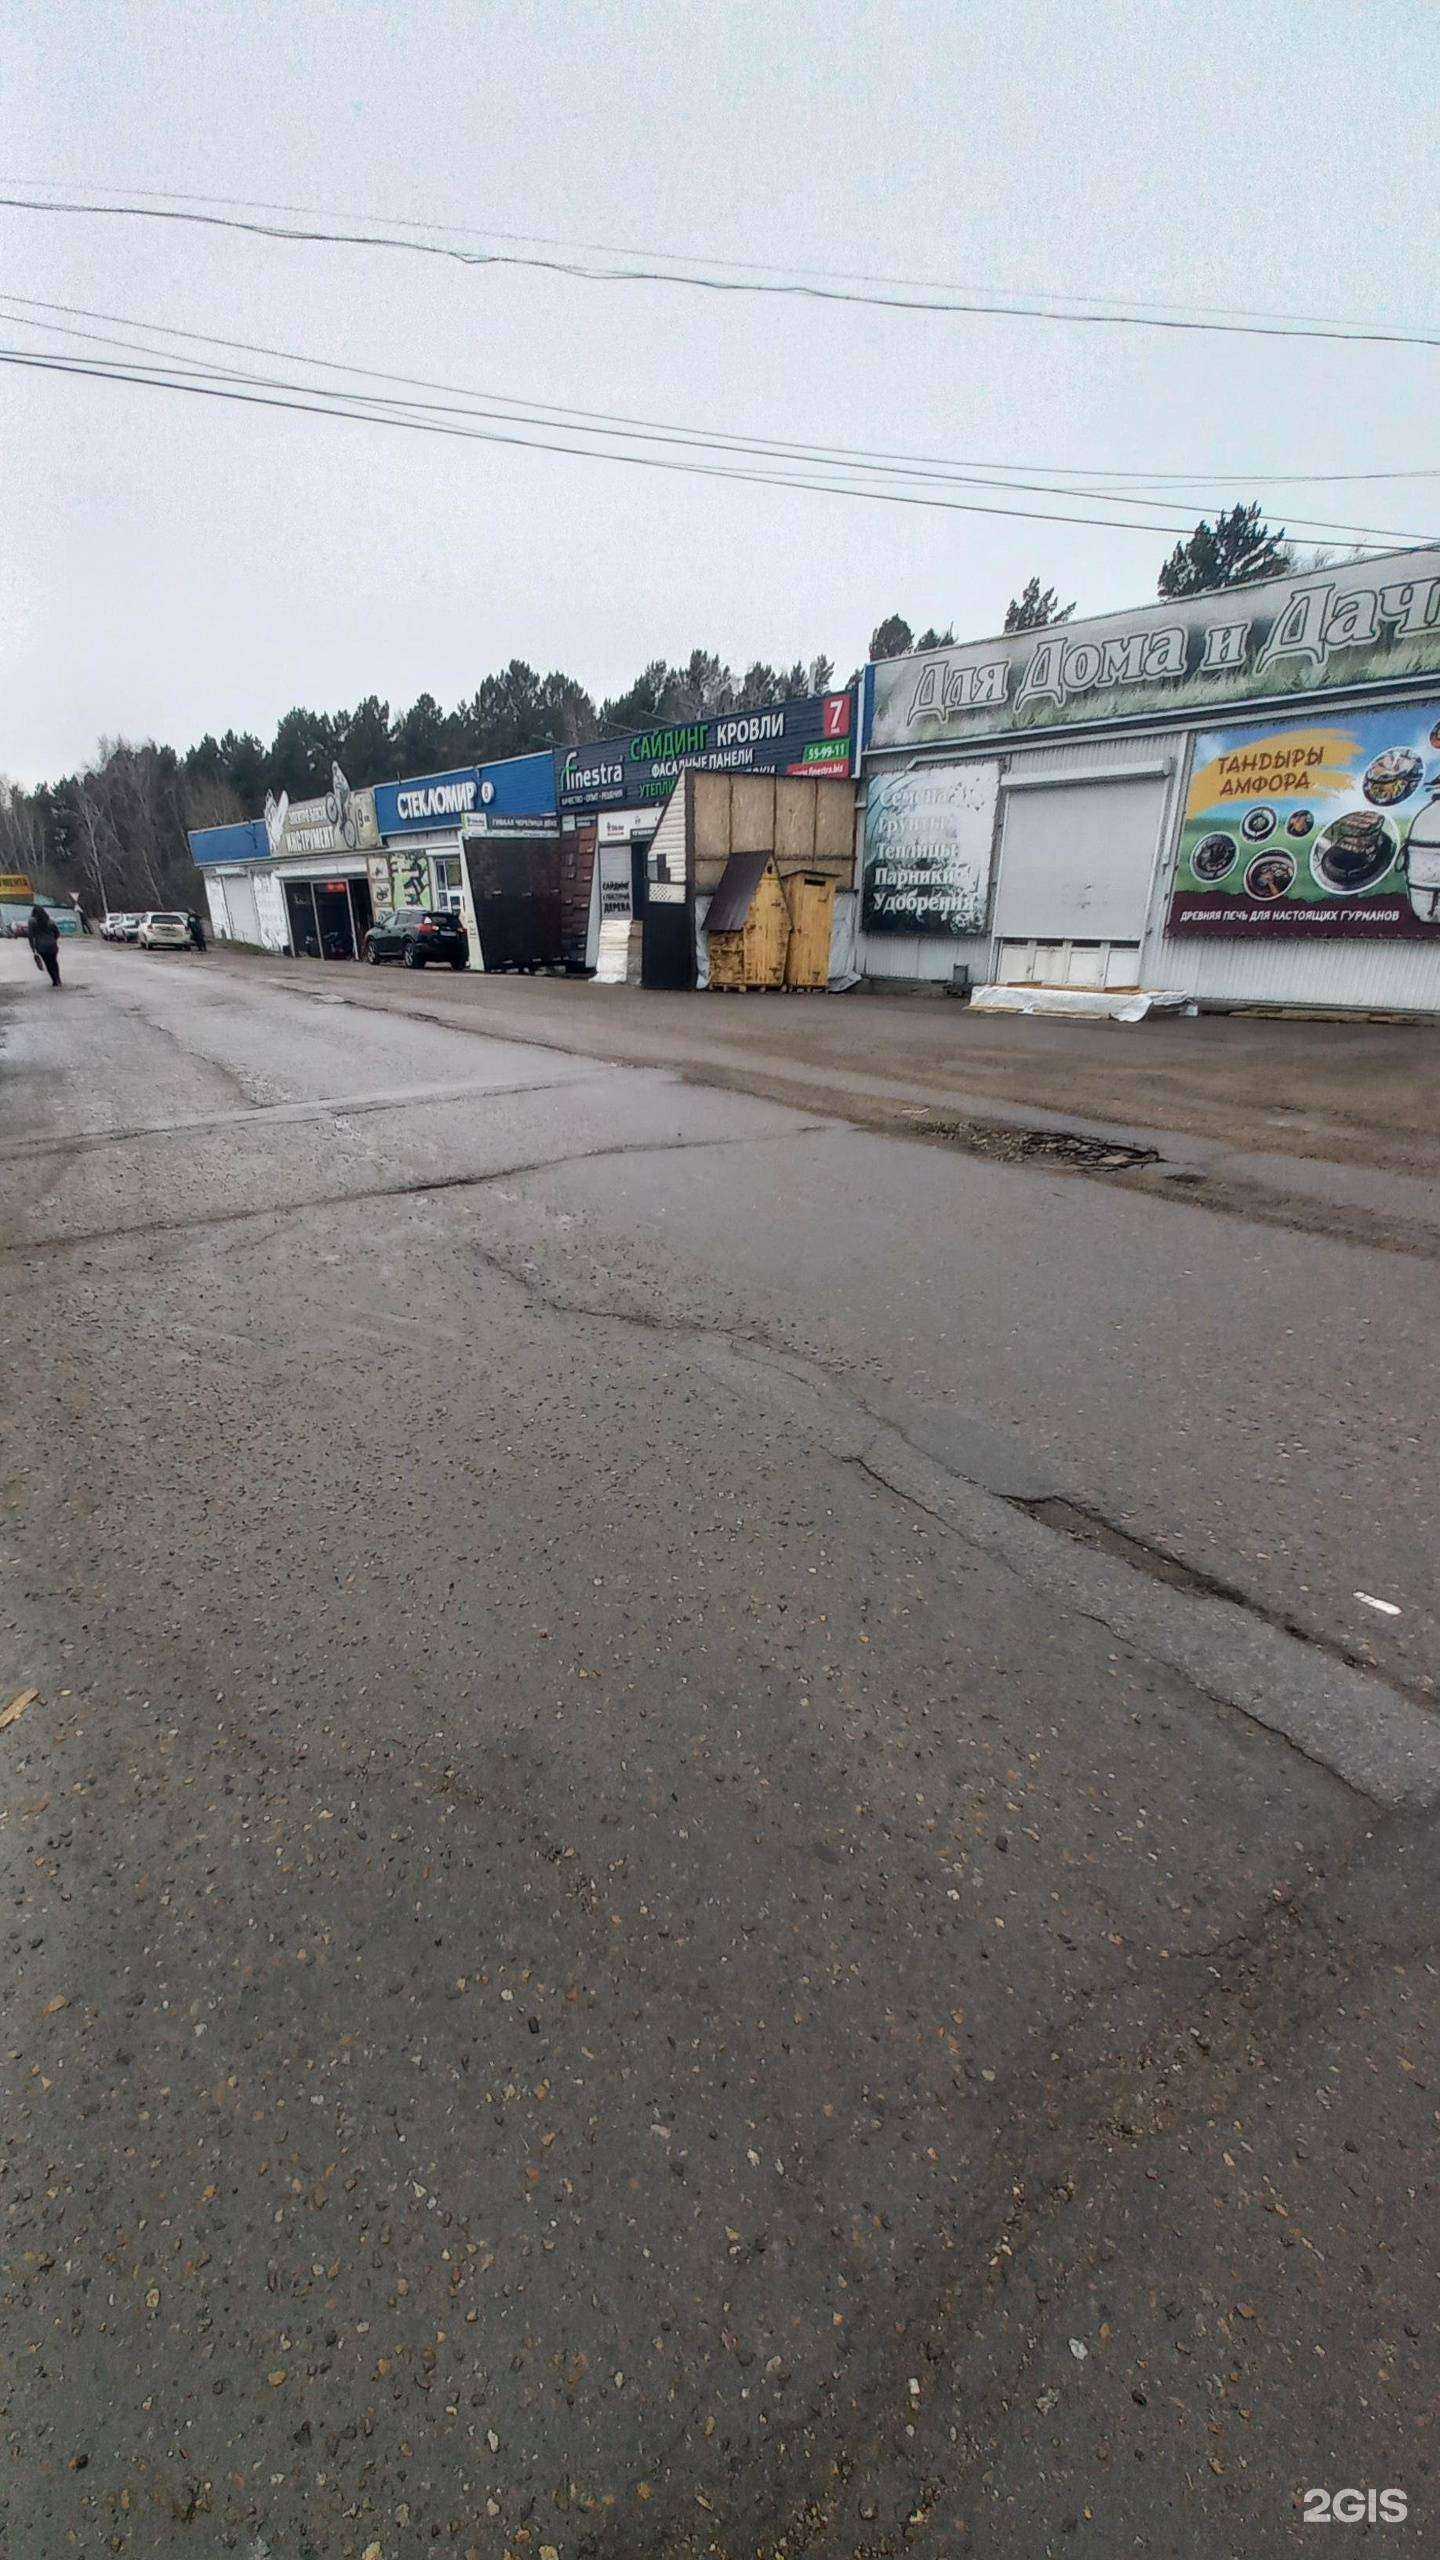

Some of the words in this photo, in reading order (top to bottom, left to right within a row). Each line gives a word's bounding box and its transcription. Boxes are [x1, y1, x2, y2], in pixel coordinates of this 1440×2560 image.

[906, 660, 1010, 727] Для
[1014, 627, 1186, 712] Дома
[1202, 624, 1248, 668] и
[1253, 577, 1440, 675] Дач
[829, 699, 844, 730] 7
[629, 724, 709, 762] САЙДИНГ
[716, 712, 784, 748] КРОВЛИ
[560, 751, 623, 792] finestra
[708, 747, 754, 770] ПАНЕЛИ
[1217, 746, 1325, 775] ТАНДЫРЫ
[1219, 771, 1312, 797] АМФОРА
[397, 781, 477, 820] СТЕКЛОМИР
[876, 840, 957, 861] Теплицы
[874, 864, 955, 890] Парники
[872, 888, 976, 918] Удобрения
[1180, 909, 1222, 922] ДРЕВНЯЯ
[1222, 909, 1248, 921] ПЕЧЬ
[1249, 910, 1270, 922] ДЛЯ
[1271, 909, 1338, 922] НАСТОЯЩИХ
[1339, 909, 1400, 921] ГУРМАНОВ
